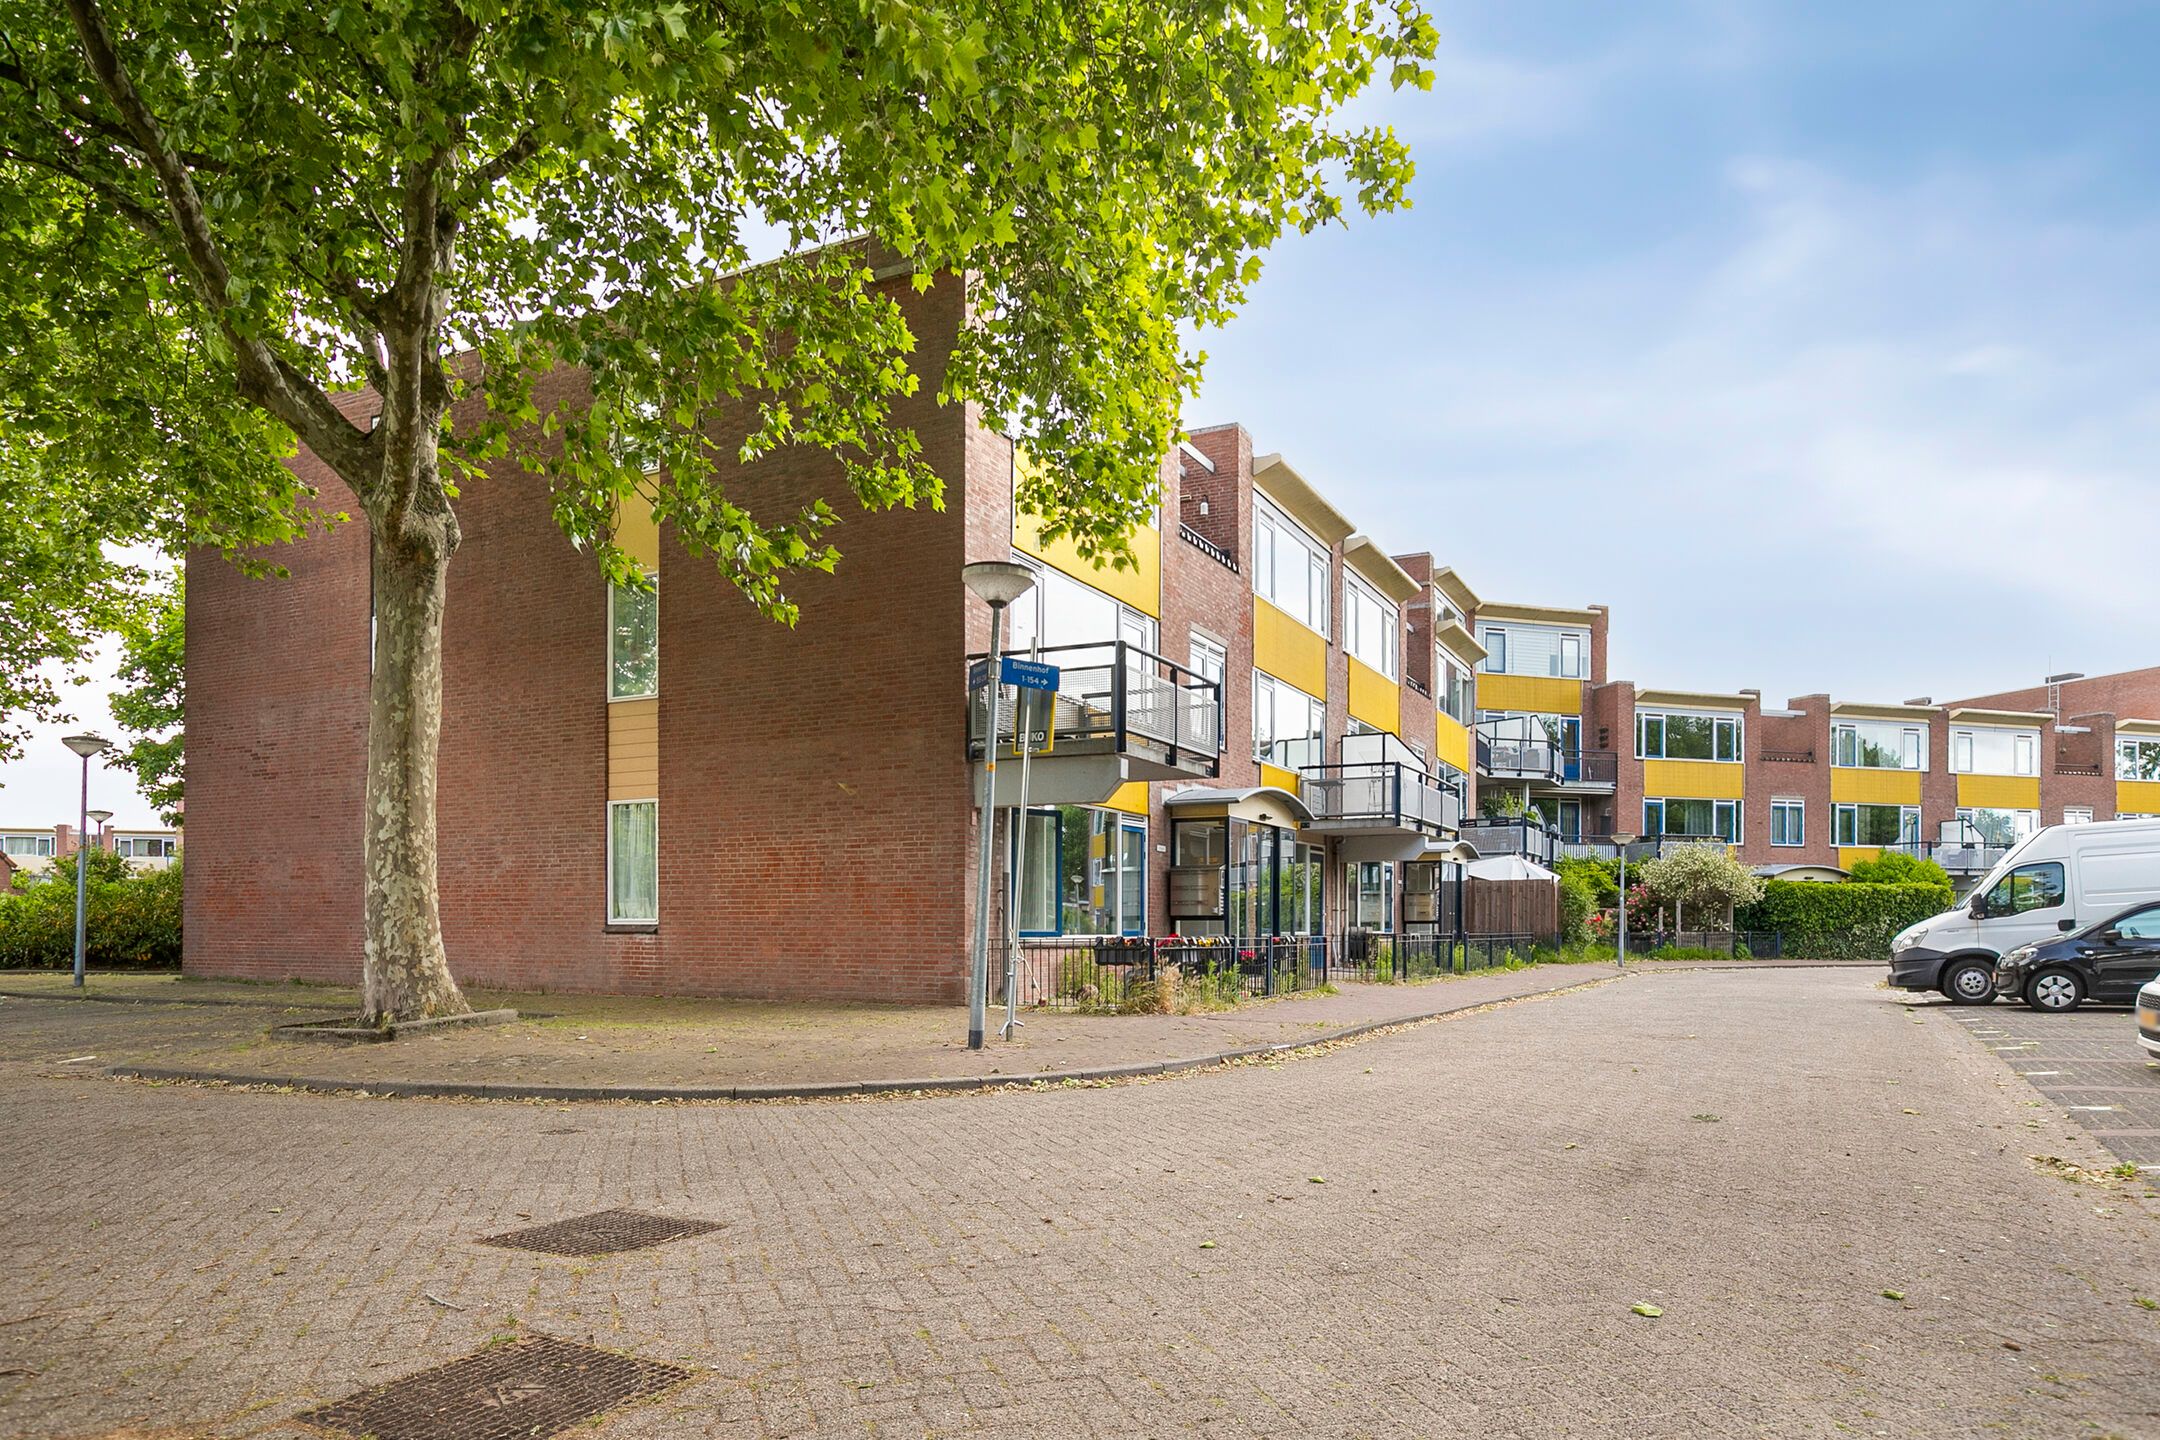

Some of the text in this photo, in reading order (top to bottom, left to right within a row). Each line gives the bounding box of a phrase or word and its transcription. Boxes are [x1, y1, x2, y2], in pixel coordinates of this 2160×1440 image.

[1012, 661, 1049, 674] Binnenhof
[1021, 675, 1039, 684] 1-154
[1019, 731, 1045, 743] BKO
